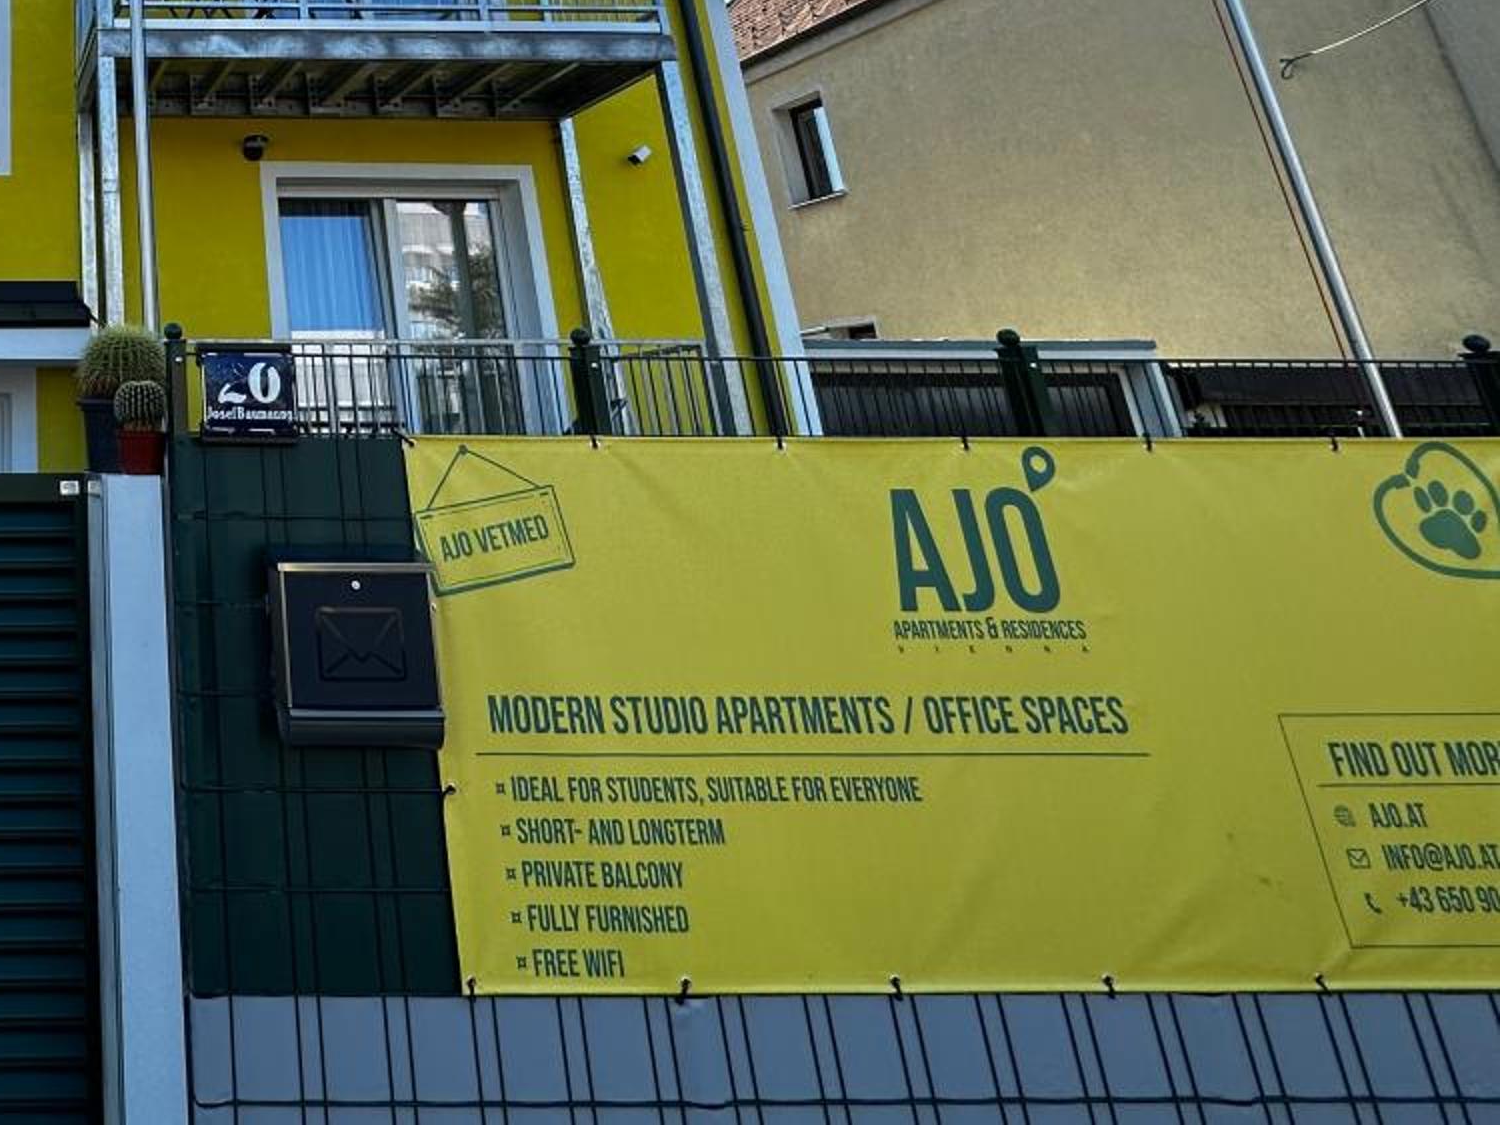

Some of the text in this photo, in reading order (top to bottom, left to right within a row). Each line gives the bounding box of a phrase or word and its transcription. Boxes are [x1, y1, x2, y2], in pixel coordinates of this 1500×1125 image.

[439, 515, 549, 562] AJO VETMED
[889, 487, 1061, 613] AJO
[893, 617, 1087, 640] APARTMENTS & RESIDENCES
[487, 694, 1129, 735] MODERN STUDIO APARTMENTS / OFFICE SPACES
[1327, 741, 1500, 777] FIND OUT MOR
[510, 776, 923, 806] IDEAL FOR STUDENTS, SUITABLE FOR EVERYONE
[1368, 802, 1429, 828] AJO.AT
[516, 818, 725, 845] SHORT- AND LONGTERM
[521, 860, 684, 888] PRIVATE BALCONY
[1396, 886, 1435, 913] +43
[1436, 886, 1475, 913] 650
[527, 904, 690, 933] FULLY FURNISHED
[532, 948, 626, 977] FREE WIFI
